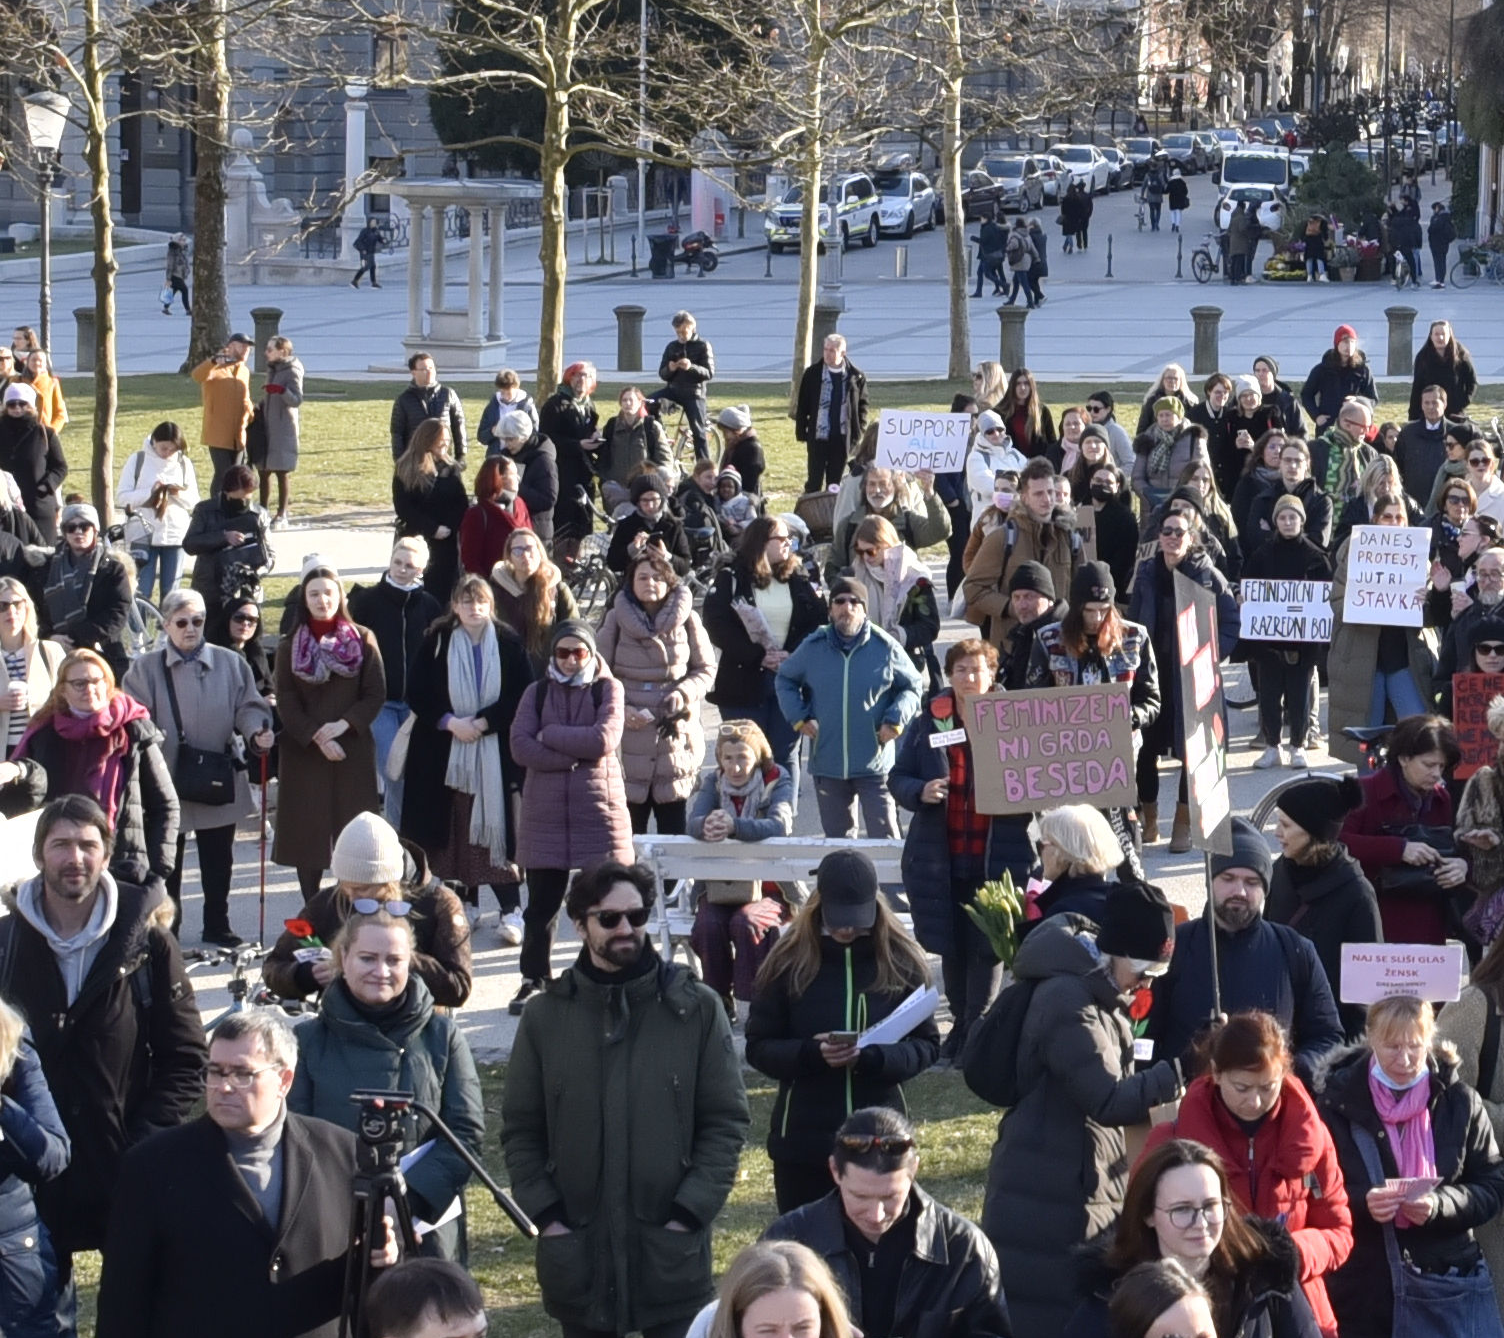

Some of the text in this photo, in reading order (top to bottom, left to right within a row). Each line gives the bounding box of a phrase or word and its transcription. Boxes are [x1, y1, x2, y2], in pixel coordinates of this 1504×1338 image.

[885, 418, 969, 438] SUPPORT
[908, 438, 939, 450] ALL
[887, 449, 958, 469] WOMEN
[1360, 531, 1412, 549] DANES
[1358, 551, 1419, 571] PROTEST,
[1245, 579, 1315, 604] FEMINISTIČNI
[1352, 589, 1423, 611] STAVKA
[1250, 616, 1332, 640] RAZREDNI BOJ
[974, 692, 1131, 735] FEMINIZEM
[998, 735, 1032, 762] NI
[1039, 728, 1112, 757] GRDA
[1004, 756, 1129, 803] BESEDA
[1352, 954, 1373, 962] NAJ
[1376, 955, 1388, 963] SE
[1418, 956, 1446, 964] GLAS
[1384, 968, 1418, 978] ŽENSK
